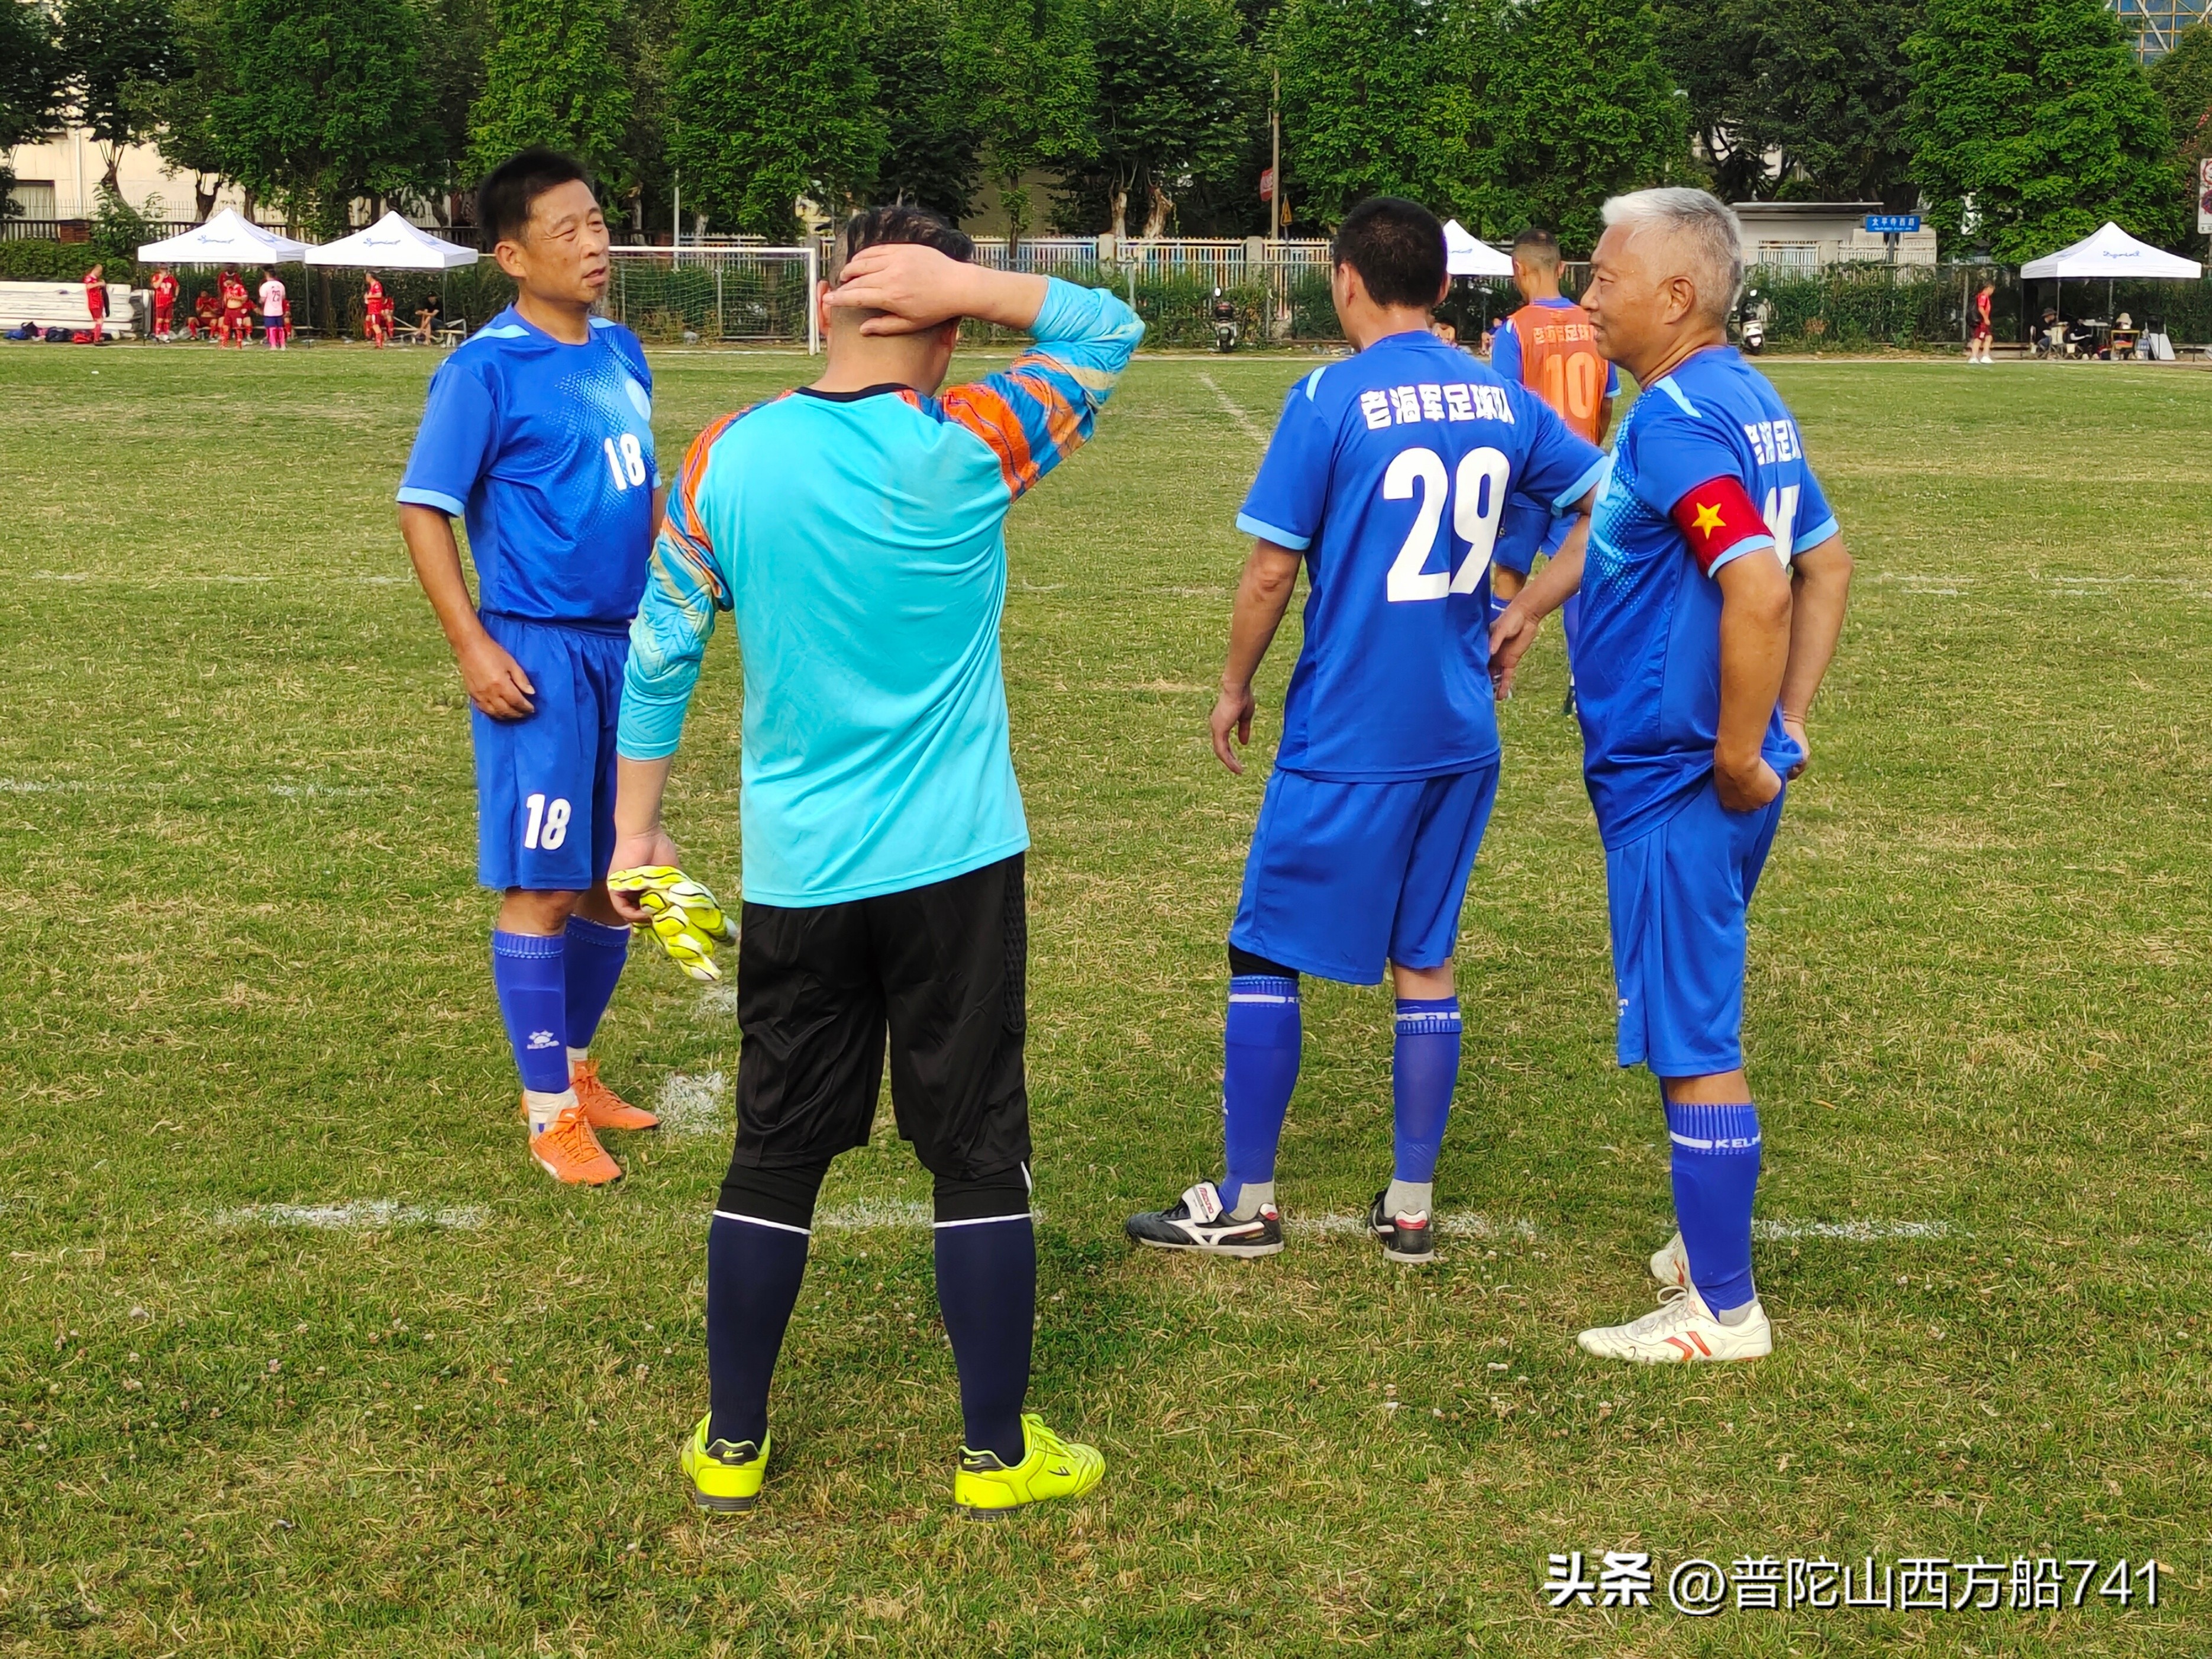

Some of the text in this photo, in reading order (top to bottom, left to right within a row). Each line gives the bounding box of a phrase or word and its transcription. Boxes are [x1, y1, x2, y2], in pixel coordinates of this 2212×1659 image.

[1546, 351, 1596, 419] 10
[604, 433, 646, 490] 18
[1383, 447, 1510, 602] 29
[524, 793, 571, 850] 18
